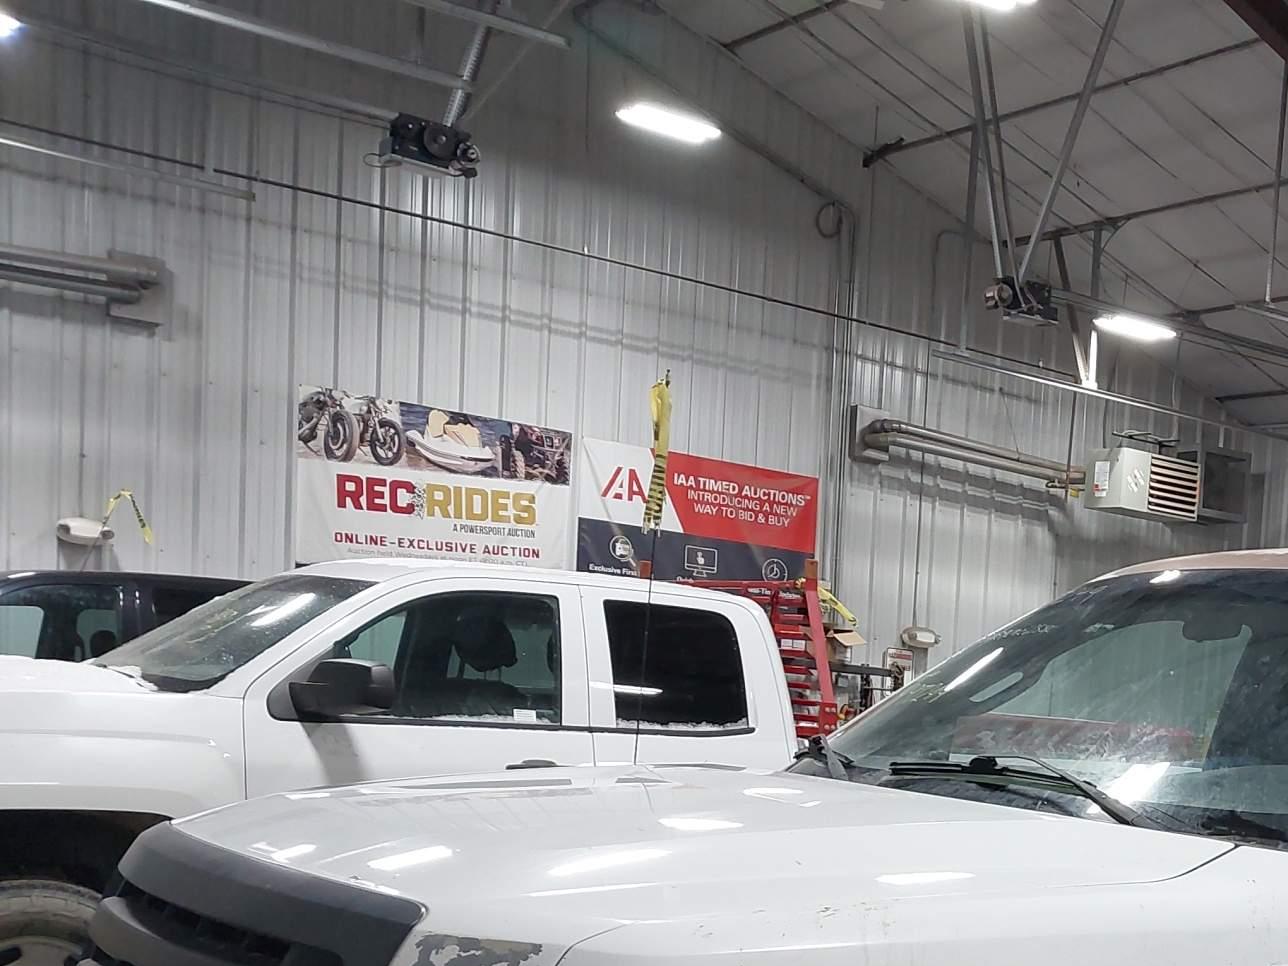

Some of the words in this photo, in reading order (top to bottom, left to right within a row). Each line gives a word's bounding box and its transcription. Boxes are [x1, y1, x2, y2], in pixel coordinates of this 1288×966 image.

[674, 472, 696, 486] IAA
[698, 477, 738, 494] TIMED
[688, 489, 760, 510] INTRODUCING
[763, 502, 770, 511] A
[773, 505, 798, 517] NEW
[694, 503, 718, 516] WAY
[720, 507, 736, 518] TO
[739, 510, 755, 522] BID
[758, 513, 765, 523] &
[768, 515, 790, 527] BUY
[460, 524, 506, 536] POWERSPORT
[507, 527, 535, 538] AUCTION
[334, 532, 477, 553] ONLINE-EXCLUSIVE
[482, 545, 540, 558] AUCTION
[589, 564, 621, 574] Exclusive
